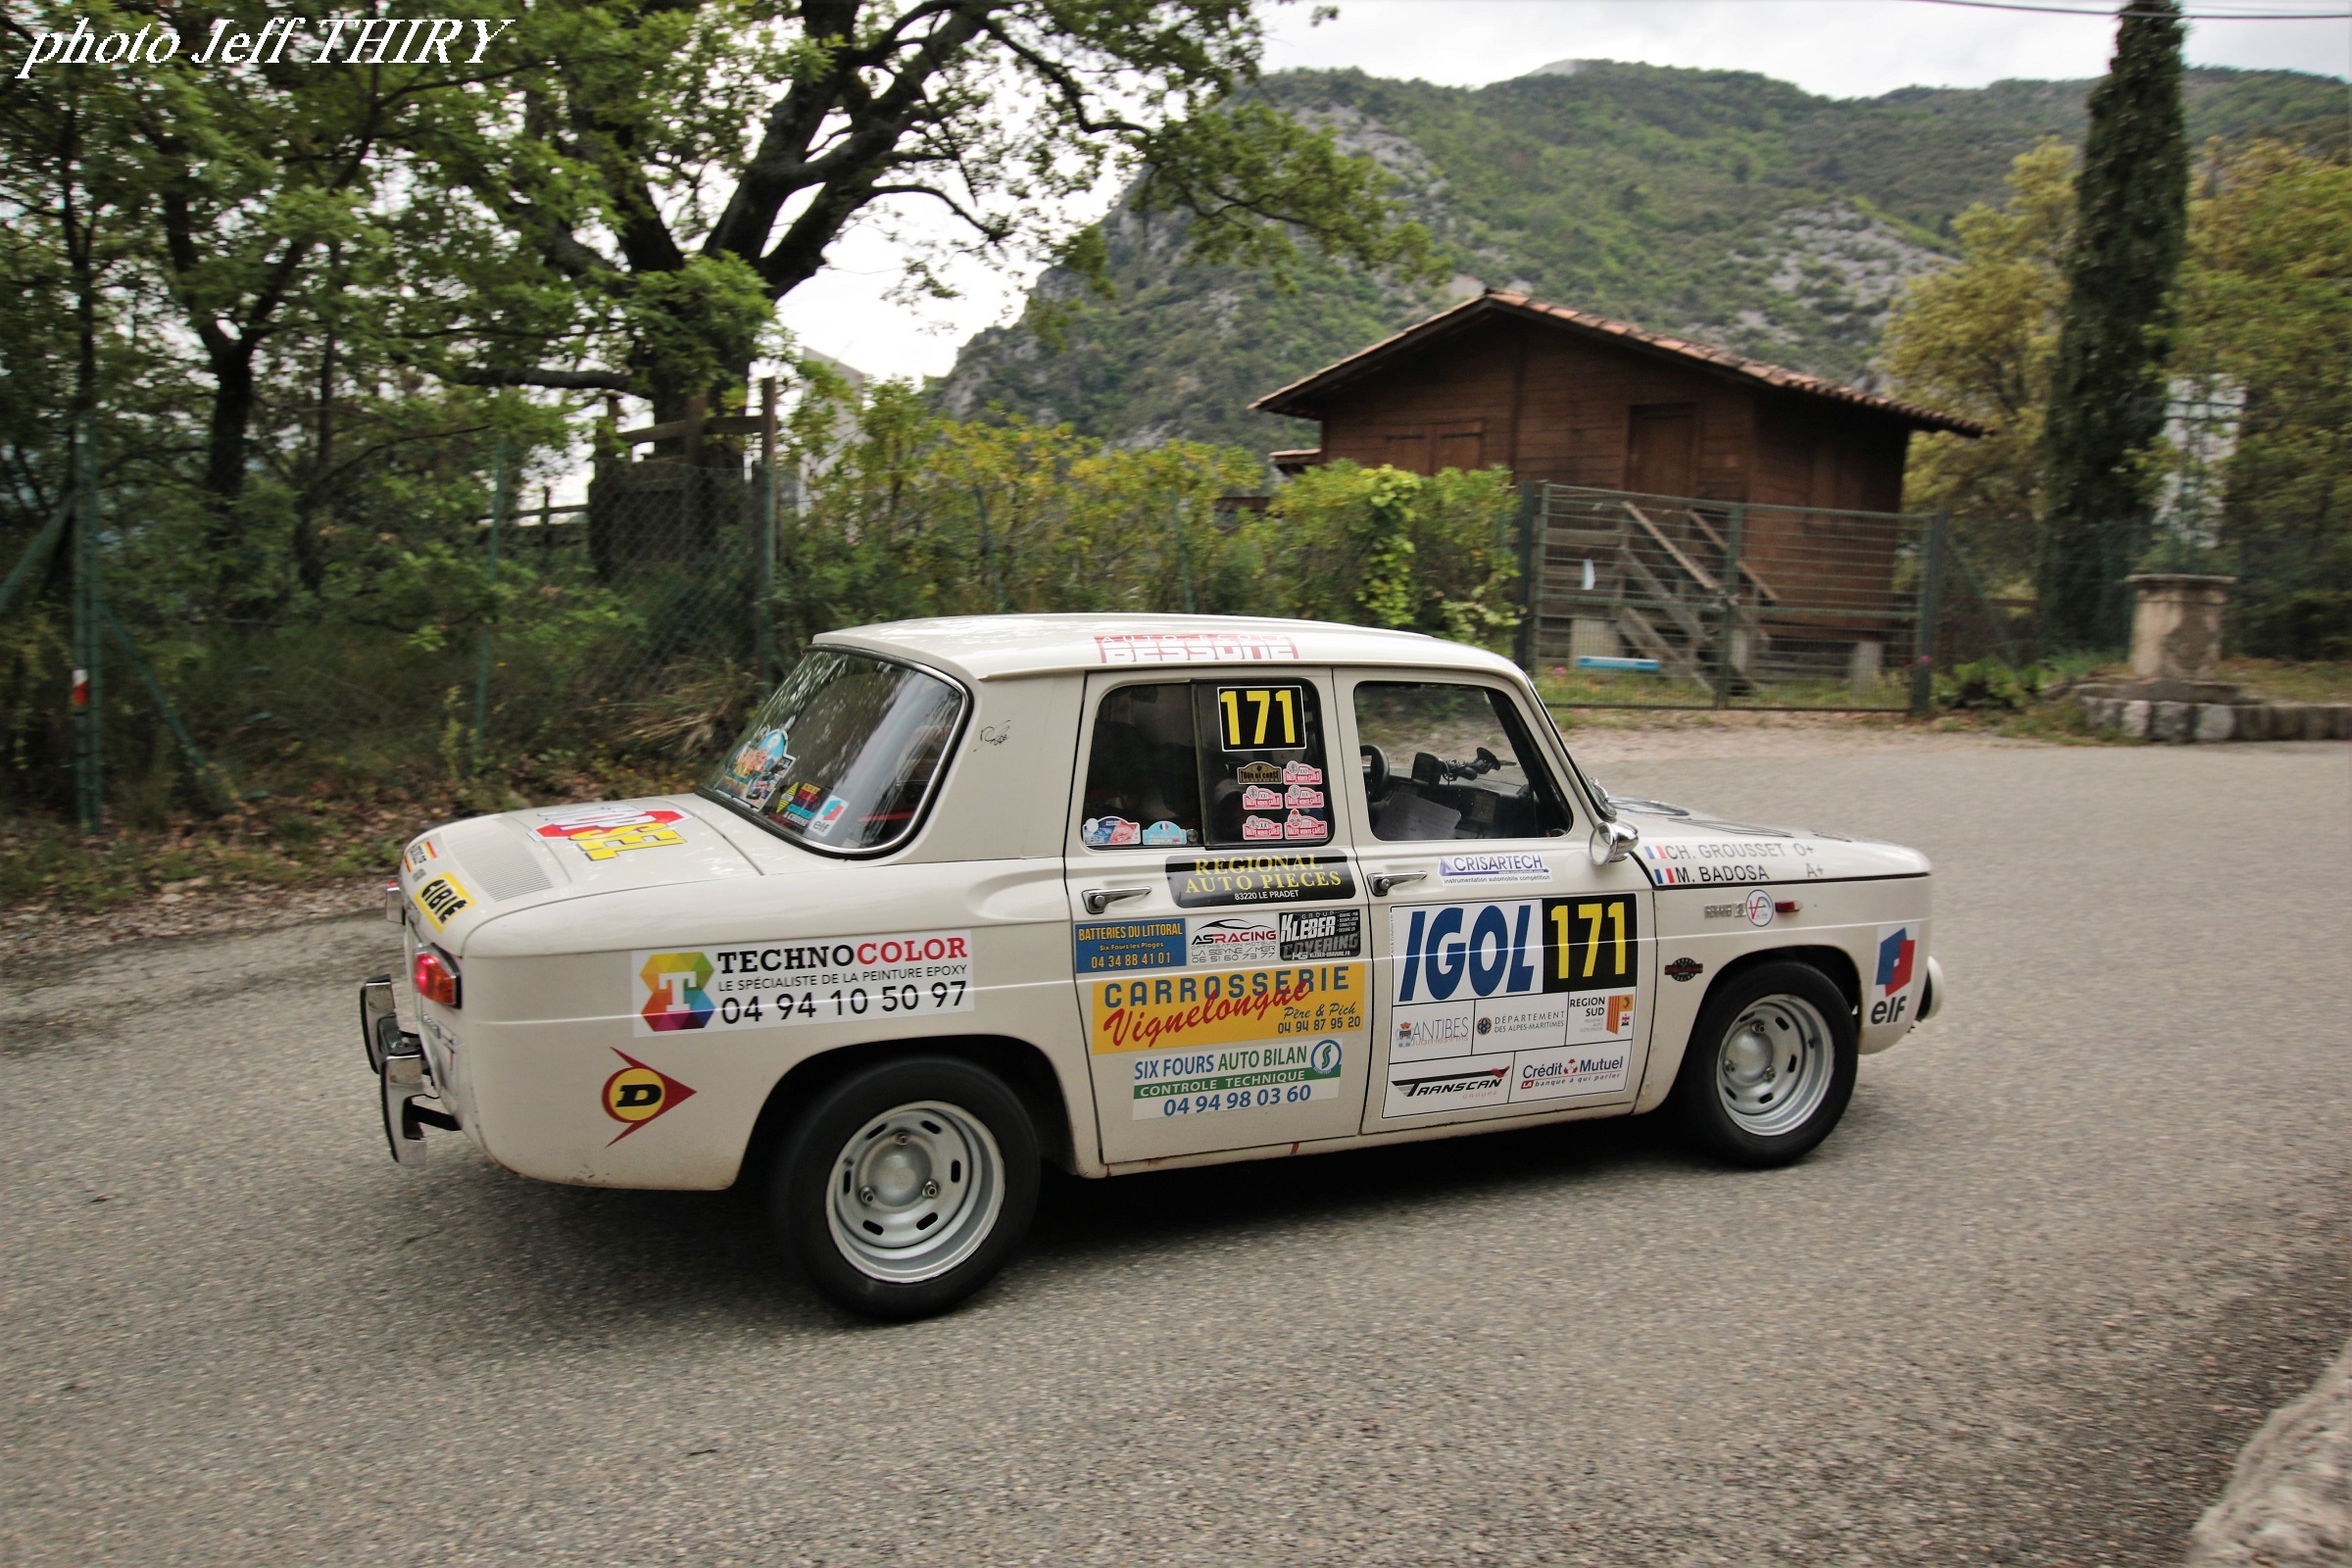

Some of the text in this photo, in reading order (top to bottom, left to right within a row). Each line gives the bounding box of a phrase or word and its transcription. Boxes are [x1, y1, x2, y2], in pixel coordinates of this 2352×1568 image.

[1220, 690, 1296, 745] 171
[812, 821, 830, 833] elf
[1666, 845, 1696, 859] CH.
[1698, 843, 1787, 858] GROUSSET
[1193, 854, 1325, 876] REGIONAL
[1453, 855, 1544, 871] CRISARTECH
[1674, 862, 1824, 883] M. BADOSA A+
[1185, 870, 1342, 894] AUTO PIECES
[1235, 890, 1299, 901] 83220 LE PRADET
[1079, 923, 1183, 941] BATTERIES DU LITTORAL
[1280, 913, 1337, 943] KLEBER
[717, 937, 968, 974] TECHNOCOLOR
[1208, 947, 1244, 956] SEYNE
[1282, 933, 1360, 958] COVERING
[1398, 902, 1626, 1002] IGOL 171
[1091, 952, 1170, 969] 04 34 88 41 01
[718, 964, 967, 992] LE SPÉCIALISTE DE LA PEINTURE EPOXY
[1104, 965, 1349, 1008] CARROSSERIE
[721, 980, 966, 1025] 04 94 10 50 97
[1103, 980, 1310, 1048] Vignelongue
[1284, 1002, 1356, 1019] Père & Pich
[1586, 1007, 1605, 1017] SUD
[1870, 996, 1906, 1025] elf
[1277, 1015, 1361, 1034] 04 94 87 95 20
[1494, 1010, 1565, 1024] DÉPARTEMENT
[1508, 1020, 1565, 1032] ALPES-MARITIMES
[1411, 1016, 1469, 1042] ANTIBES
[1134, 1045, 1307, 1080] SIX FOURS AUTO BILAN
[1523, 1055, 1624, 1078] Crédit Mutuel
[1140, 1070, 1305, 1098] CONTROLE TECHNIQUE
[1393, 1074, 1504, 1098] TRANSCAN
[1535, 1079, 1565, 1088] banque
[1593, 1073, 1620, 1082] parler
[614, 1083, 662, 1107] D
[1163, 1084, 1311, 1116] 04 94 98 03 60
[1462, 1090, 1498, 1099] GROUPE
